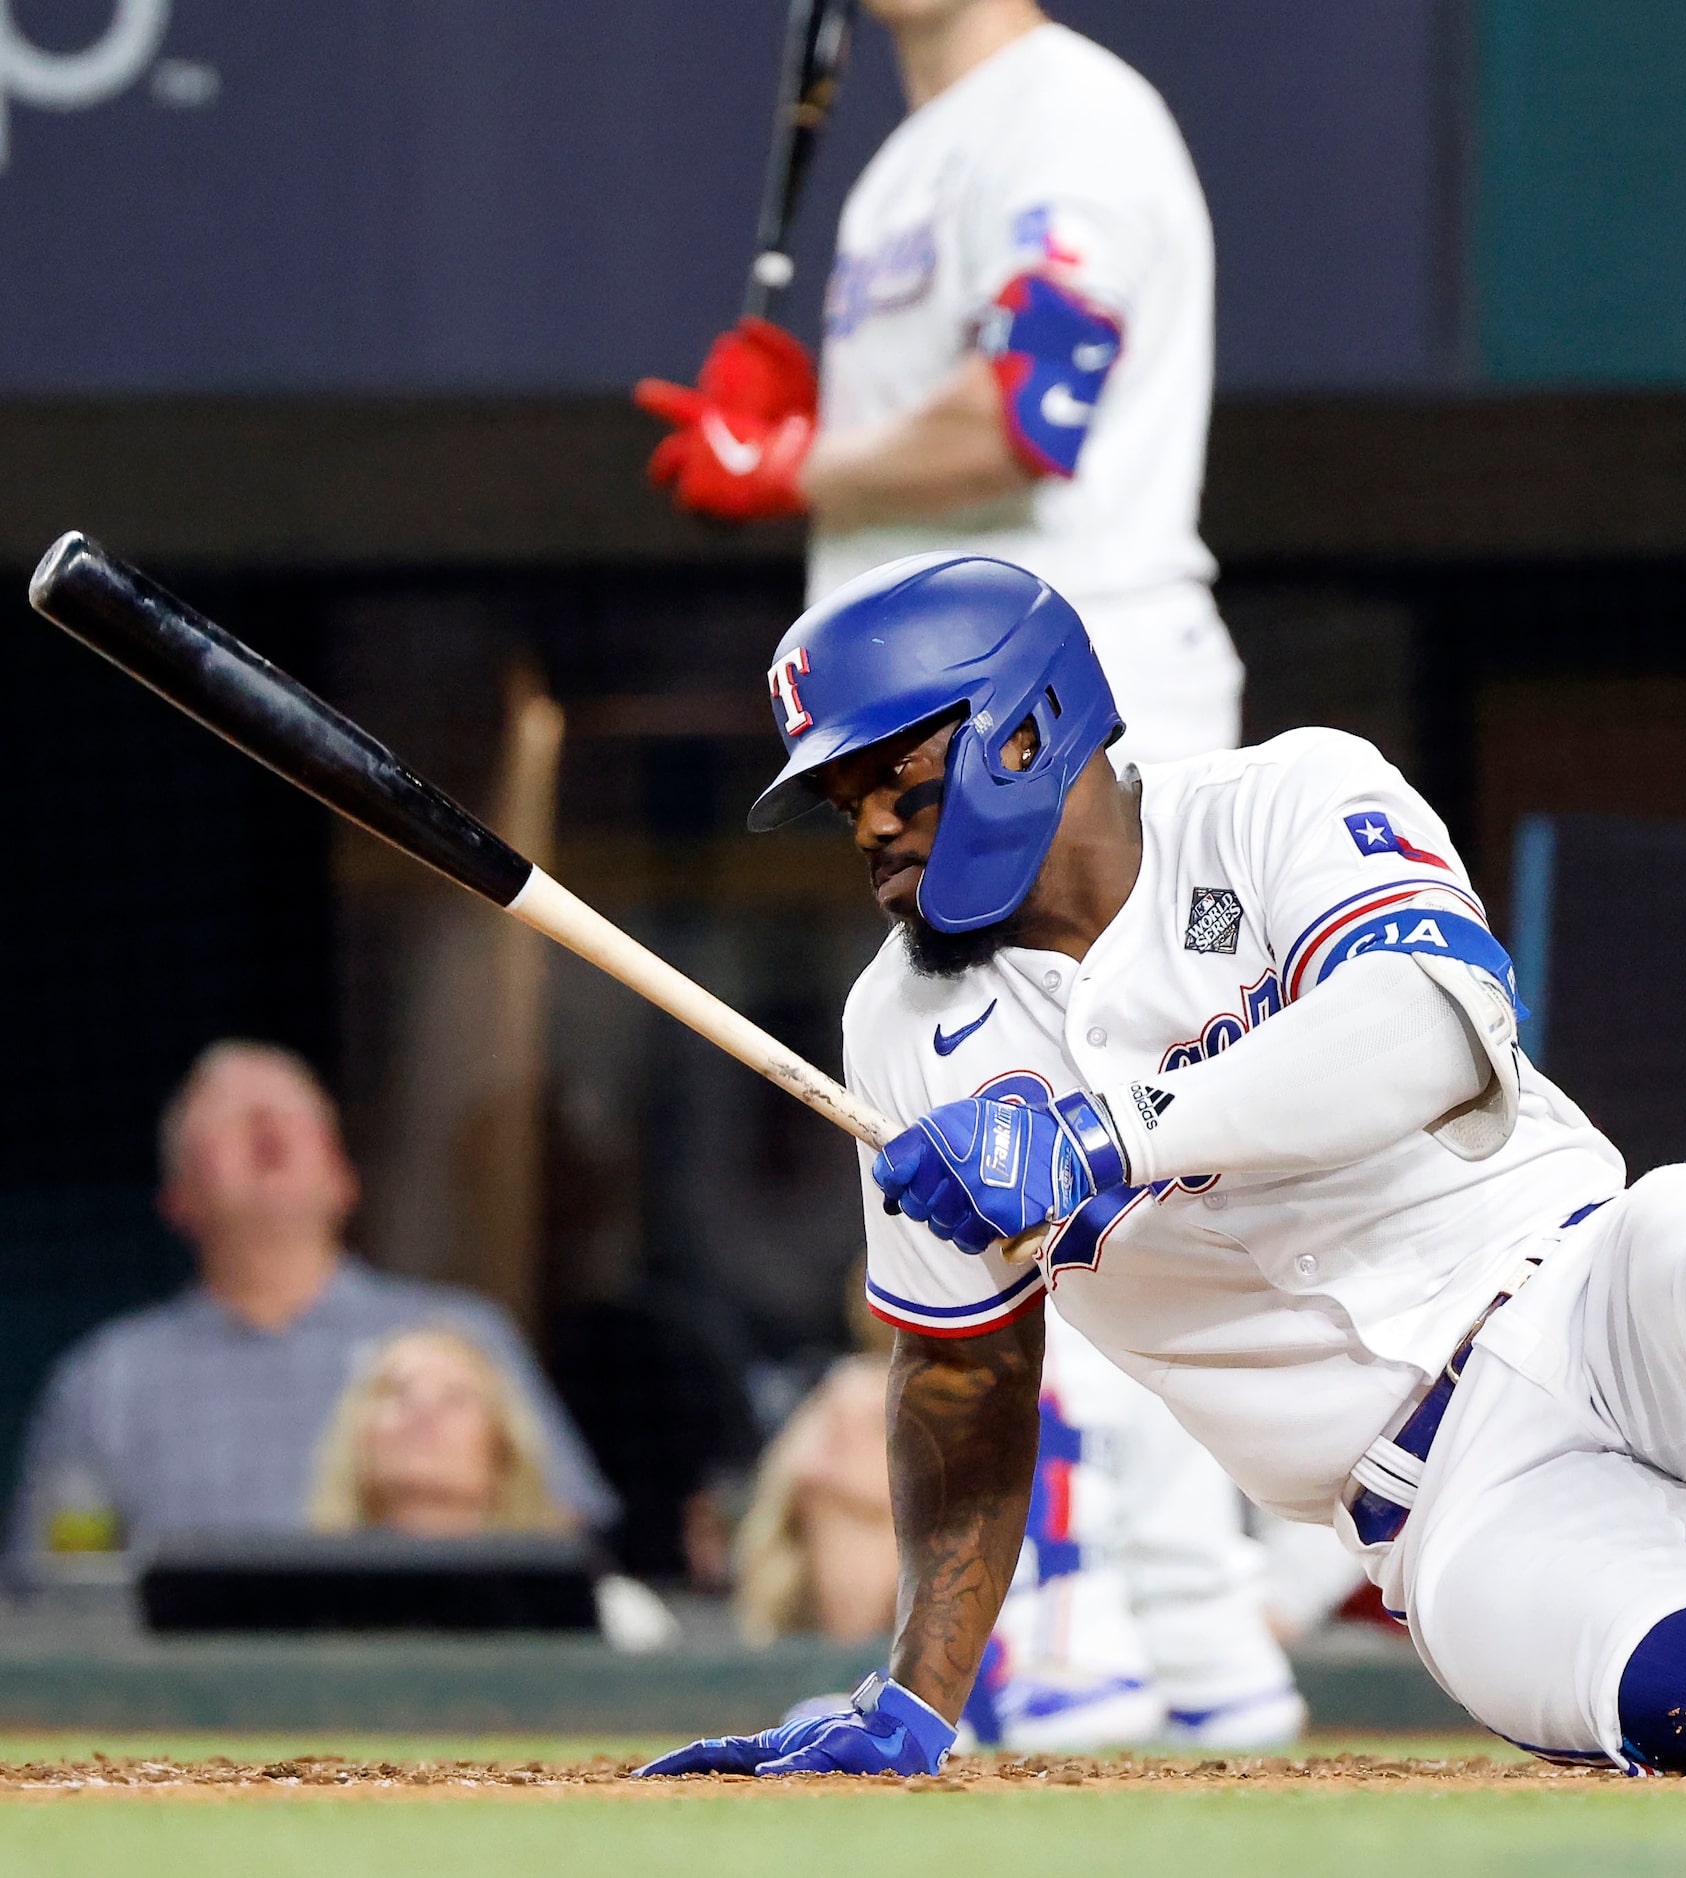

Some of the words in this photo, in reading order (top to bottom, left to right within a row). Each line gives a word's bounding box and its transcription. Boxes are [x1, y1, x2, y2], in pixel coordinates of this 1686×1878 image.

[767, 646, 813, 737] T
[1188, 892, 1234, 939] WORLD
[1195, 902, 1241, 951] SERIES
[1130, 1084, 1158, 1130] adidas
